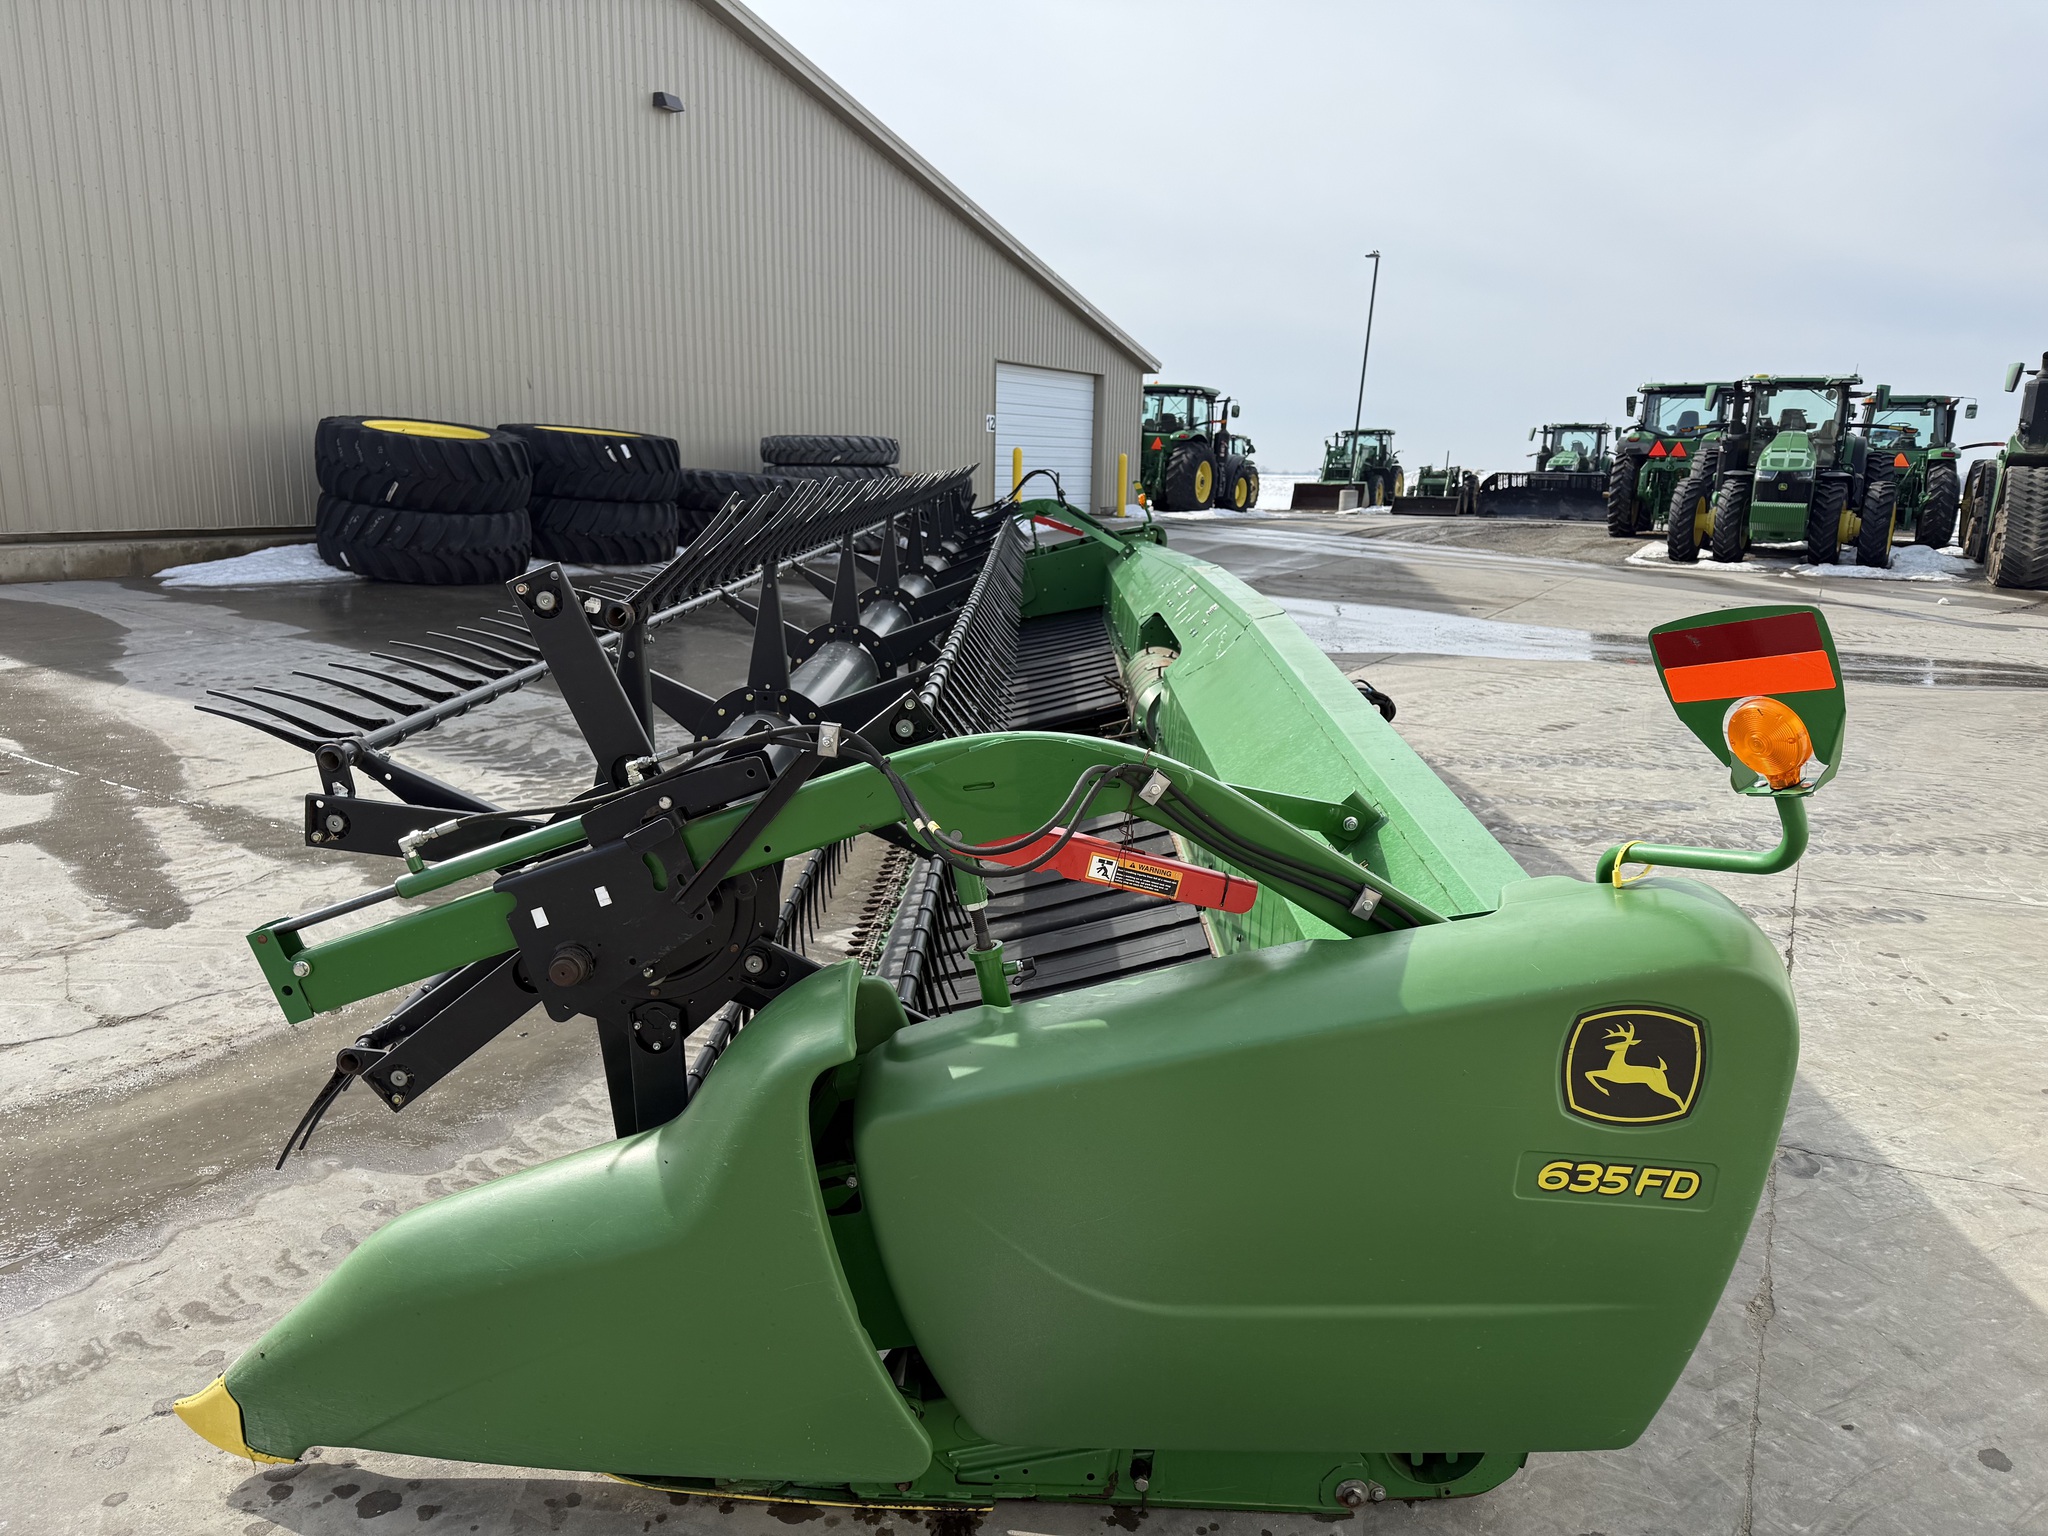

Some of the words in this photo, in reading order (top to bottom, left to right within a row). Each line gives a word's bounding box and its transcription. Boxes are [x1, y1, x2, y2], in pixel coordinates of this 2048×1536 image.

[987, 416, 996, 430] 12
[1138, 864, 1172, 877] WARNING
[1537, 1159, 1702, 1200] 635FD
